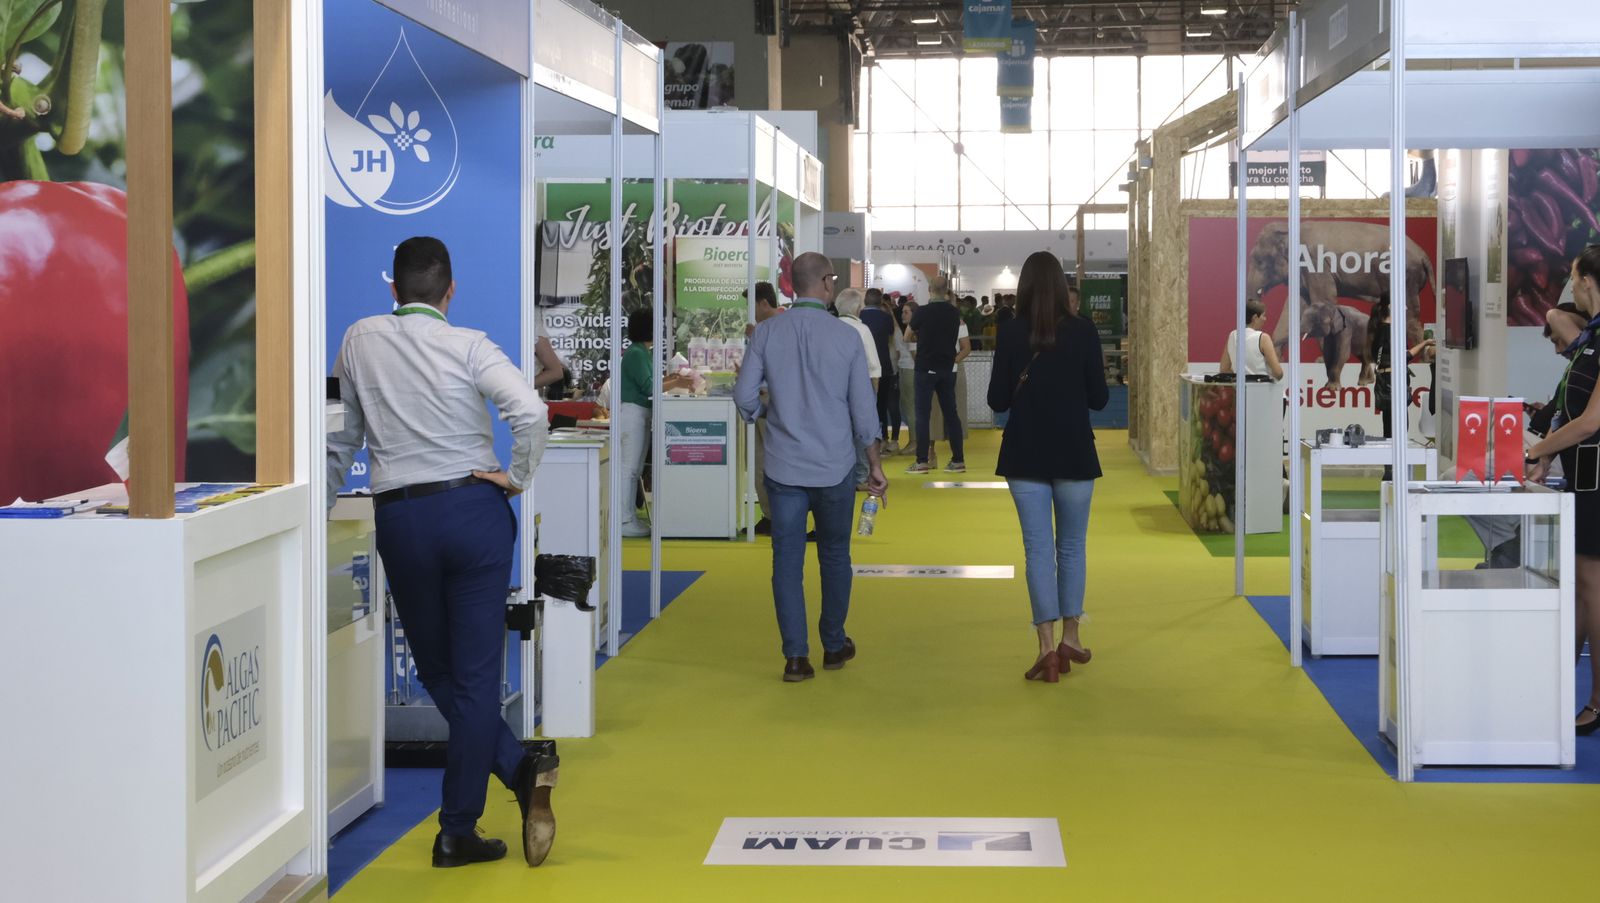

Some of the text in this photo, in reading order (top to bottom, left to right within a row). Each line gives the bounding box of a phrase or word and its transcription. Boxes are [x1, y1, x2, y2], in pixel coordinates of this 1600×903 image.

[968, 4, 1005, 14] cajamar
[665, 84, 699, 94] grupo
[350, 150, 387, 173] JH
[1248, 165, 1277, 176] mejor
[1274, 175, 1314, 183] coscha
[553, 202, 638, 249] Just
[1299, 244, 1392, 274] Ahora
[226, 645, 259, 700] ALGAS
[217, 688, 259, 749] PACIFIC
[742, 837, 926, 851] CUAM
